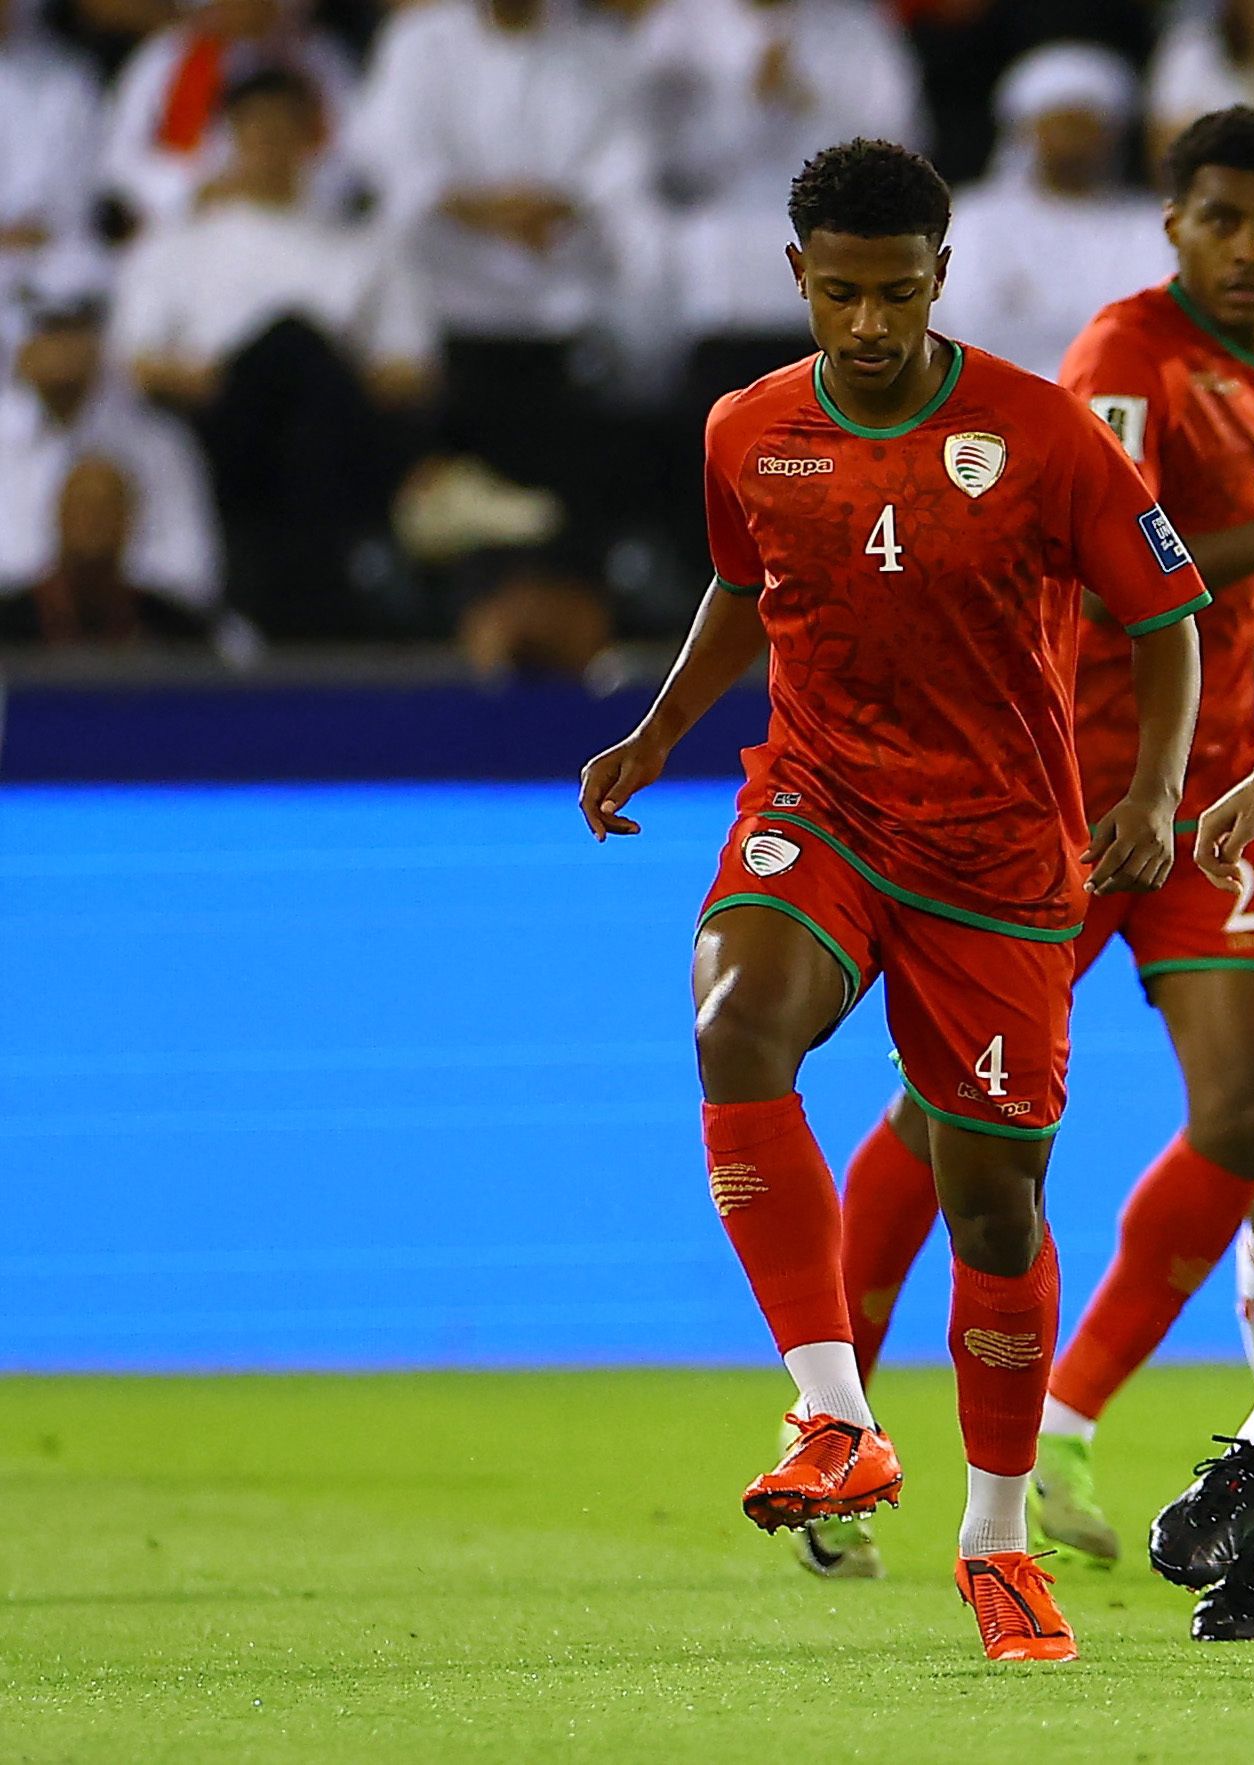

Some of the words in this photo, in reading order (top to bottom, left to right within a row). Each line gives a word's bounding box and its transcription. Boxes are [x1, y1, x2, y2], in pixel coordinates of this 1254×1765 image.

[758, 457, 834, 476] Kappa
[865, 504, 904, 572] 4
[975, 1034, 1009, 1096] 4
